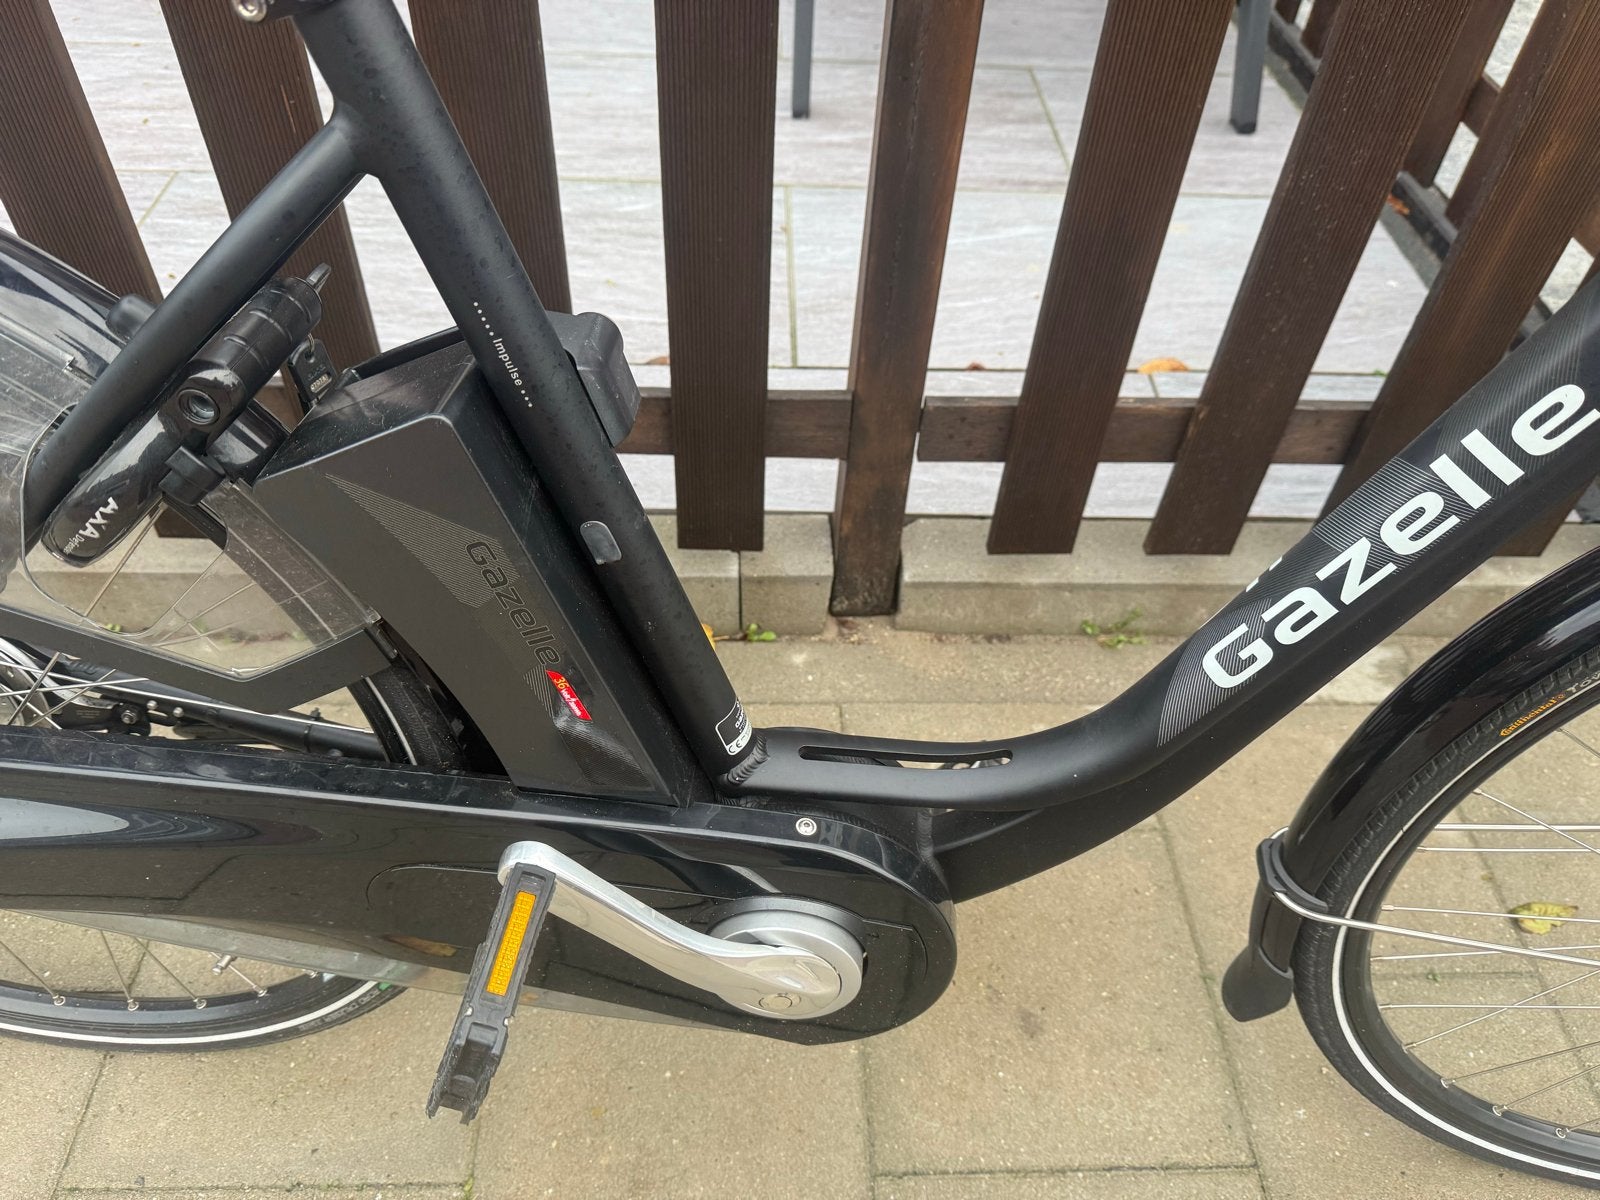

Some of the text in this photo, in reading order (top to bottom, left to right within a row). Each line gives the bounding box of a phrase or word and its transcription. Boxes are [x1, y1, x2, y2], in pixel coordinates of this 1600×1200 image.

[493, 338, 523, 386] Impulse
[79, 497, 119, 538] AXA
[1202, 384, 1600, 689] Gazelle
[465, 541, 561, 666] Gazelle
[554, 676, 570, 690] 36
